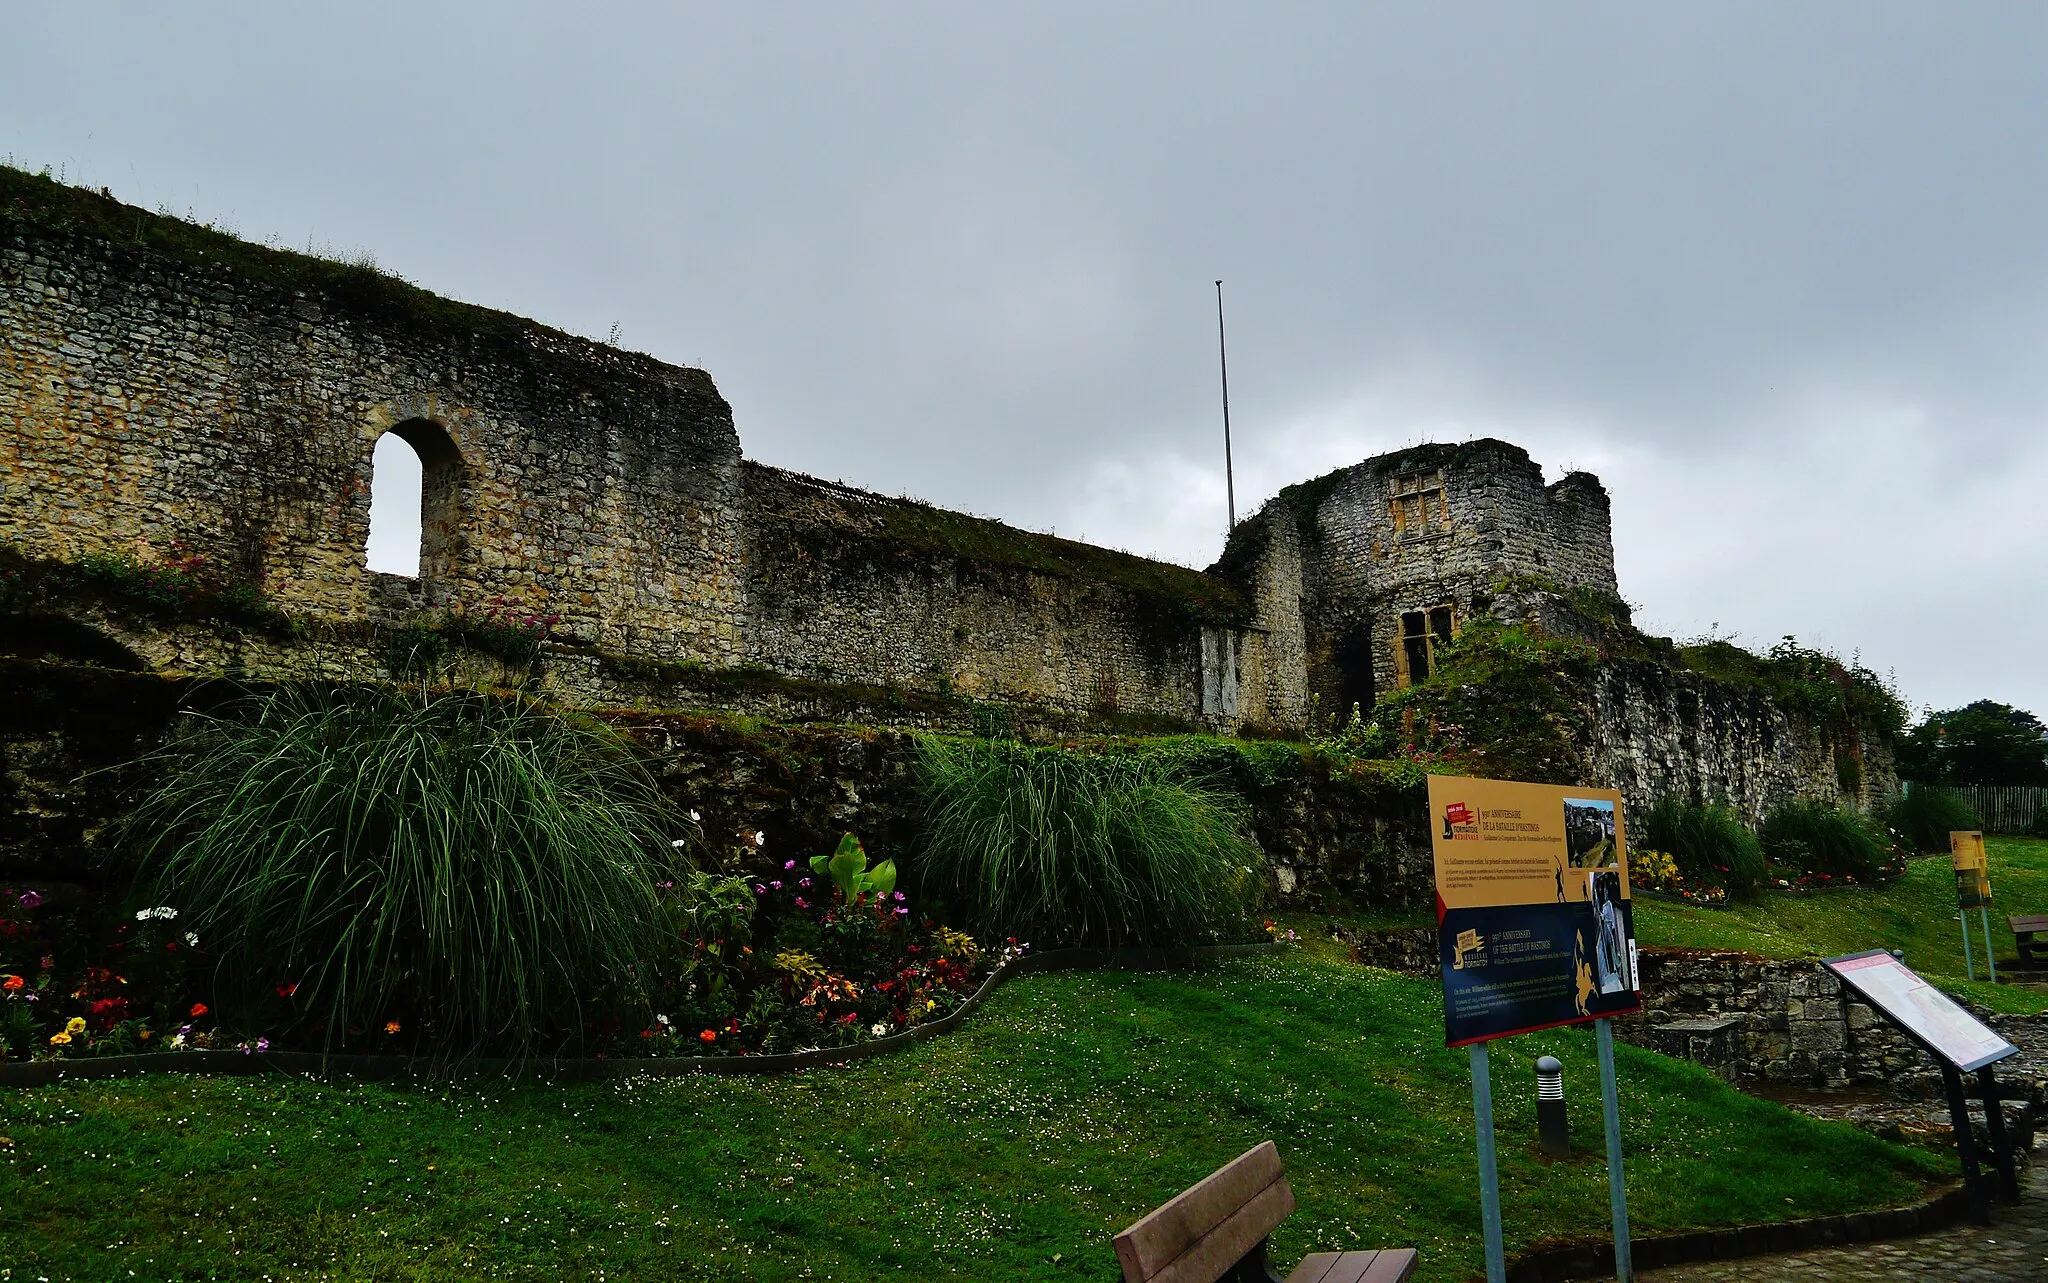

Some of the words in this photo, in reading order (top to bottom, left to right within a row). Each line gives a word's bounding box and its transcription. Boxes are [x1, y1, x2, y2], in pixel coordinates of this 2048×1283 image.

[1491, 809, 1522, 819] ANNIVERSAIRE
[1483, 822, 1489, 830] DE
[1490, 822, 1496, 831] LA
[1496, 823, 1515, 832] BATAILLE
[1502, 929, 1531, 941] ANNIVERSARY
[1492, 945, 1500, 954] OF
[1500, 944, 1509, 954] THE
[1509, 943, 1524, 953] BATTLE
[1524, 942, 1531, 951] OF
[1531, 940, 1551, 951] HASTINGS
